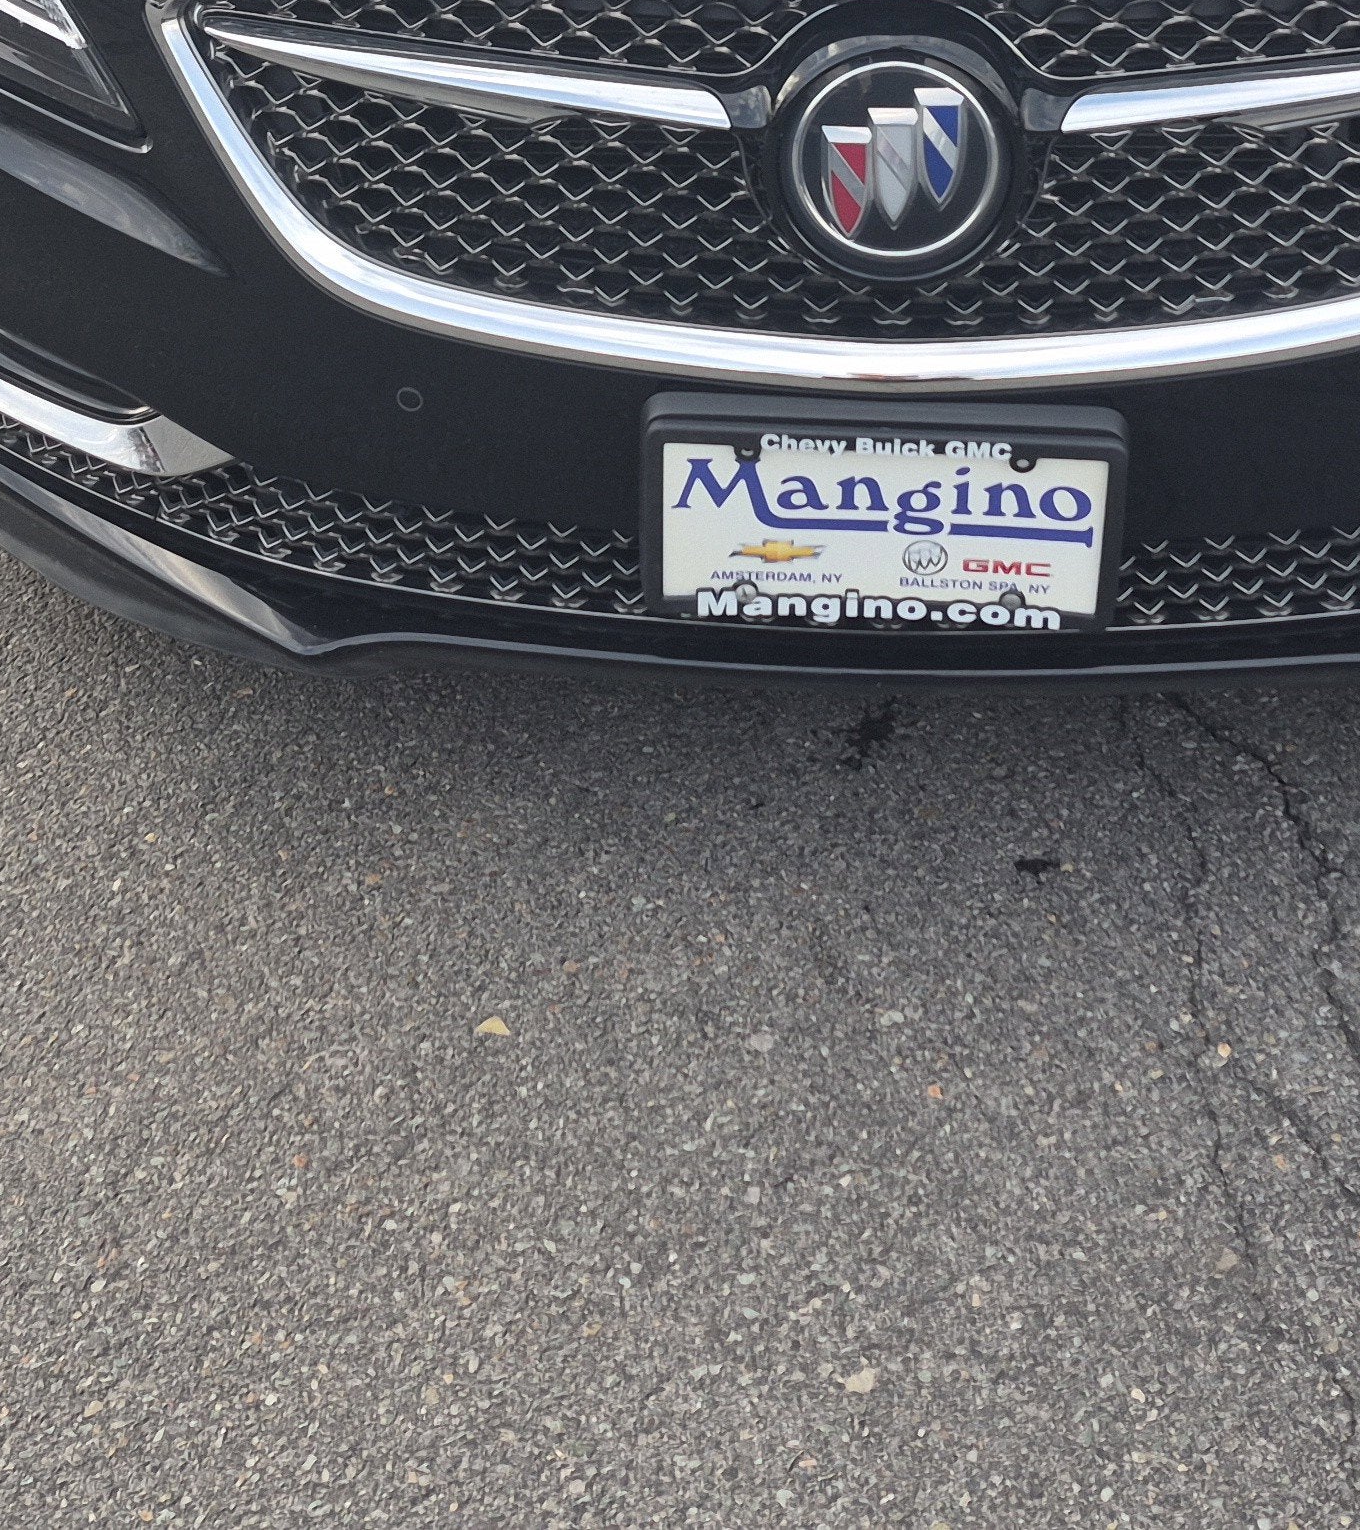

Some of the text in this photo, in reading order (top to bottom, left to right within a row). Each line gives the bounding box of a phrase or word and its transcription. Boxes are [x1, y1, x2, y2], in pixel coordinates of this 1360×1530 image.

[760, 433, 1013, 462] Chevy Buick GMC
[671, 458, 1093, 536] Mangino
[710, 570, 843, 584] AMSTERDAM, NY
[962, 558, 1052, 577] GMC
[899, 576, 984, 591] BALLSTON
[1028, 583, 1052, 594] NY
[697, 591, 1061, 631] Mangino.com
